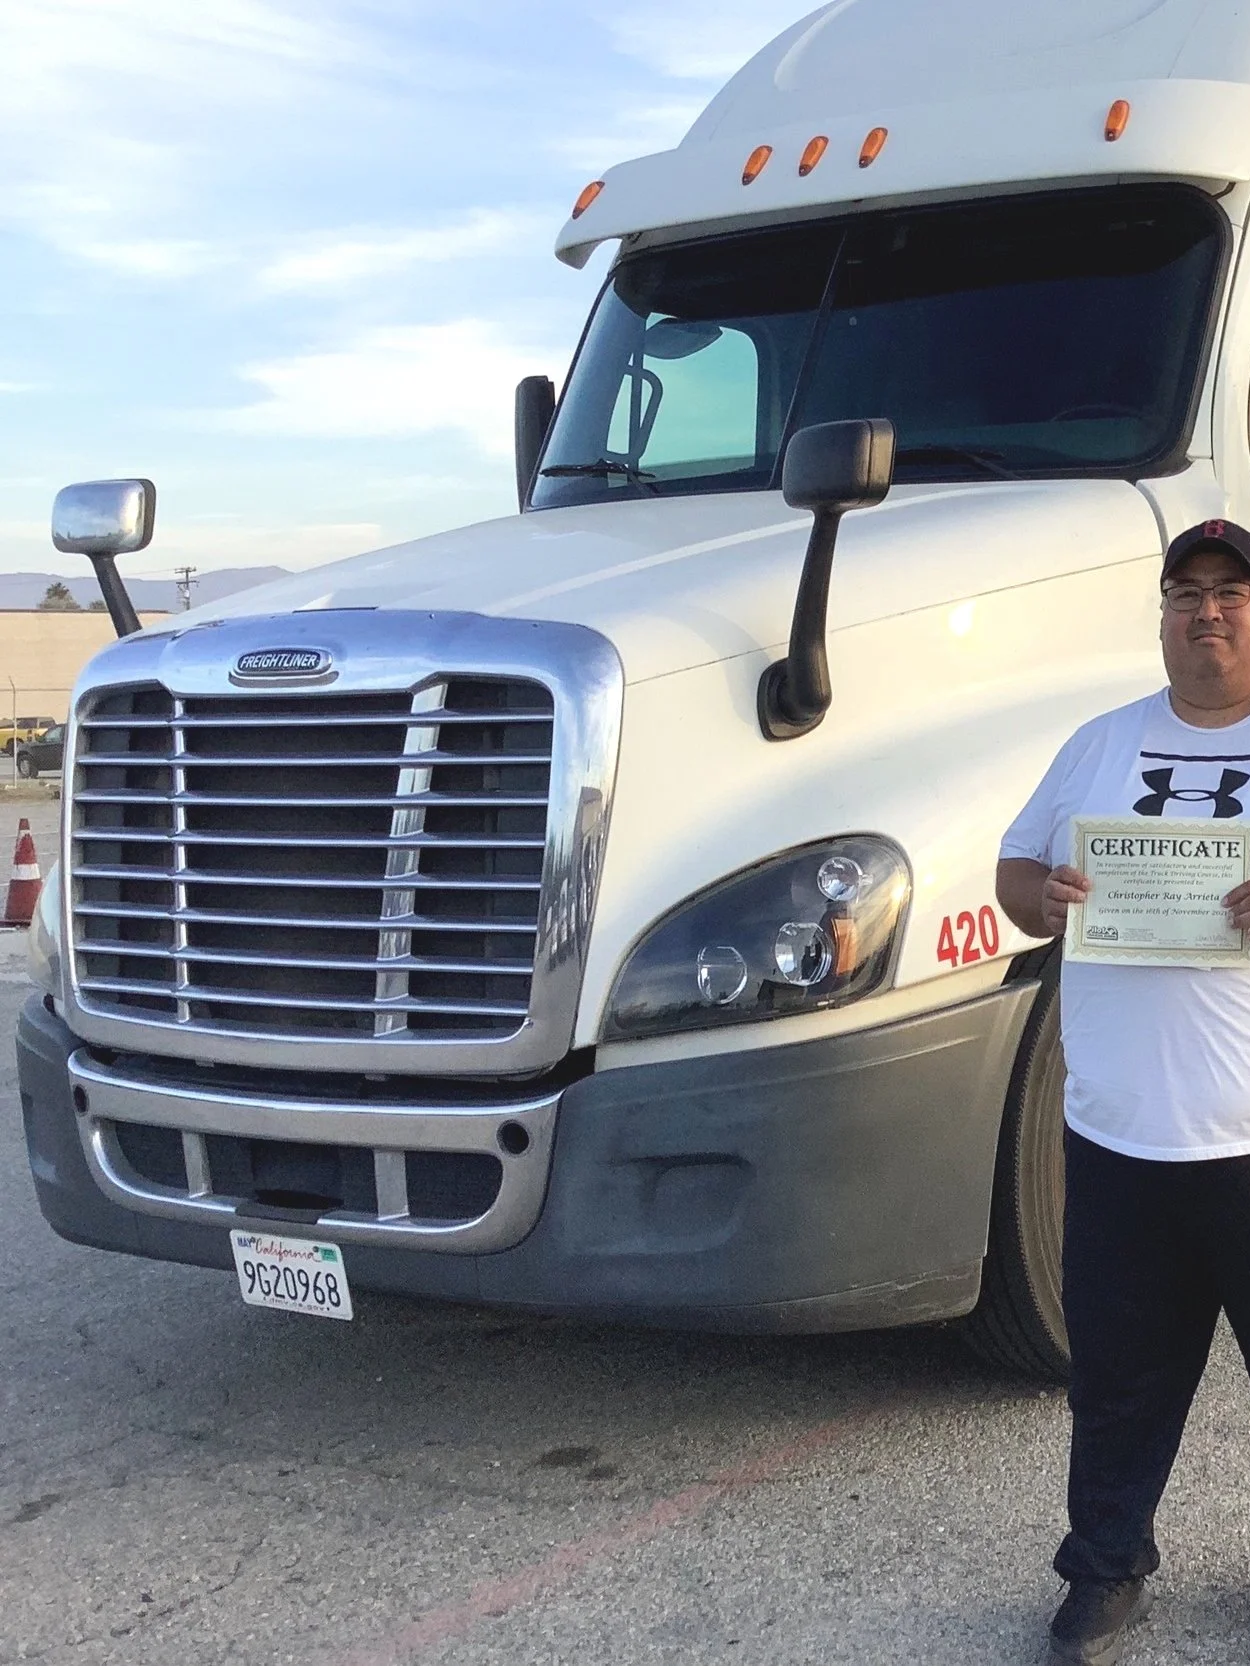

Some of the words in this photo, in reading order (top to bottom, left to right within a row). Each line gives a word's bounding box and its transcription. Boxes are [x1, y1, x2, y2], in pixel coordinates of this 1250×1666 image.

[240, 653, 318, 669] FREIGHTLINER
[1090, 837, 1242, 859] CERTIFICATE
[1107, 889, 1160, 902] Christopher
[1163, 892, 1182, 903] Ray
[1183, 892, 1220, 901] Arrieta
[1098, 907, 1120, 915] Given
[1162, 907, 1170, 916] of
[1171, 908, 1211, 916] November
[936, 904, 1000, 968] 420
[255, 1237, 321, 1262] California
[243, 1260, 341, 1308] 9G20968
